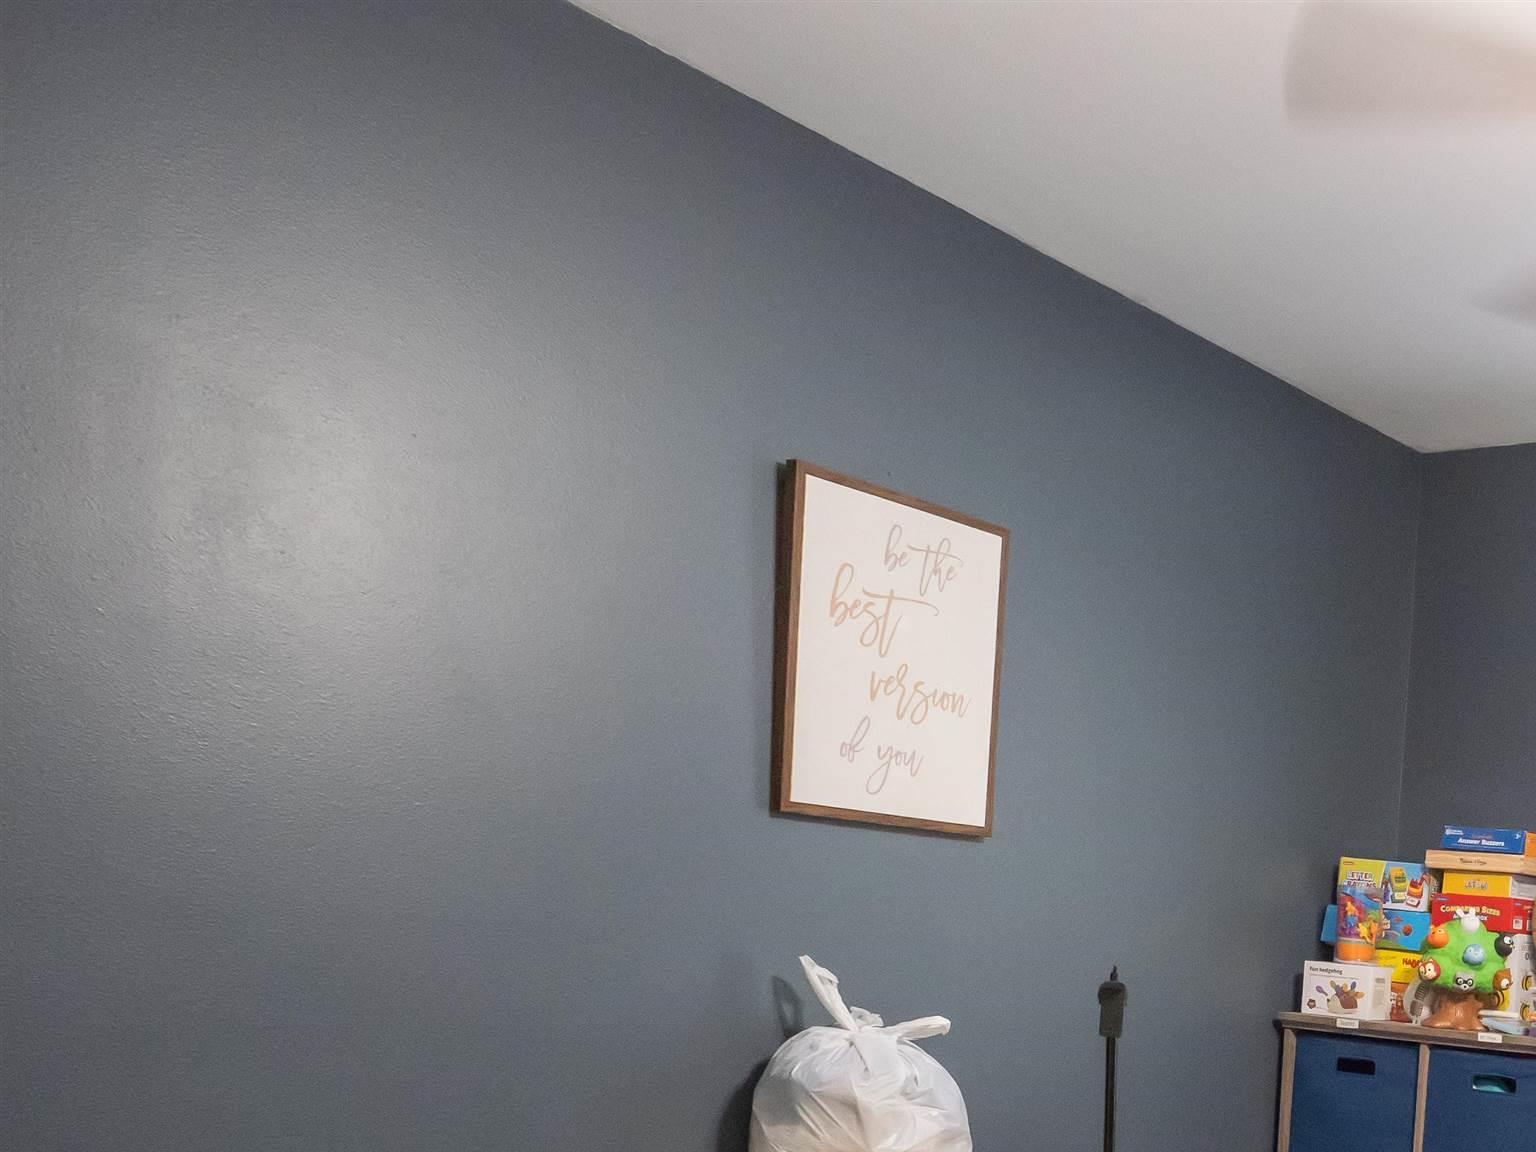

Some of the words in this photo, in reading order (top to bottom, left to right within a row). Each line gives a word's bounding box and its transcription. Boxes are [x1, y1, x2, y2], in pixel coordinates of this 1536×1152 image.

[884, 524, 911, 572] be
[907, 537, 964, 597] the
[829, 563, 940, 658] best
[870, 663, 971, 725] version
[839, 716, 871, 766] of
[865, 746, 924, 795] you
